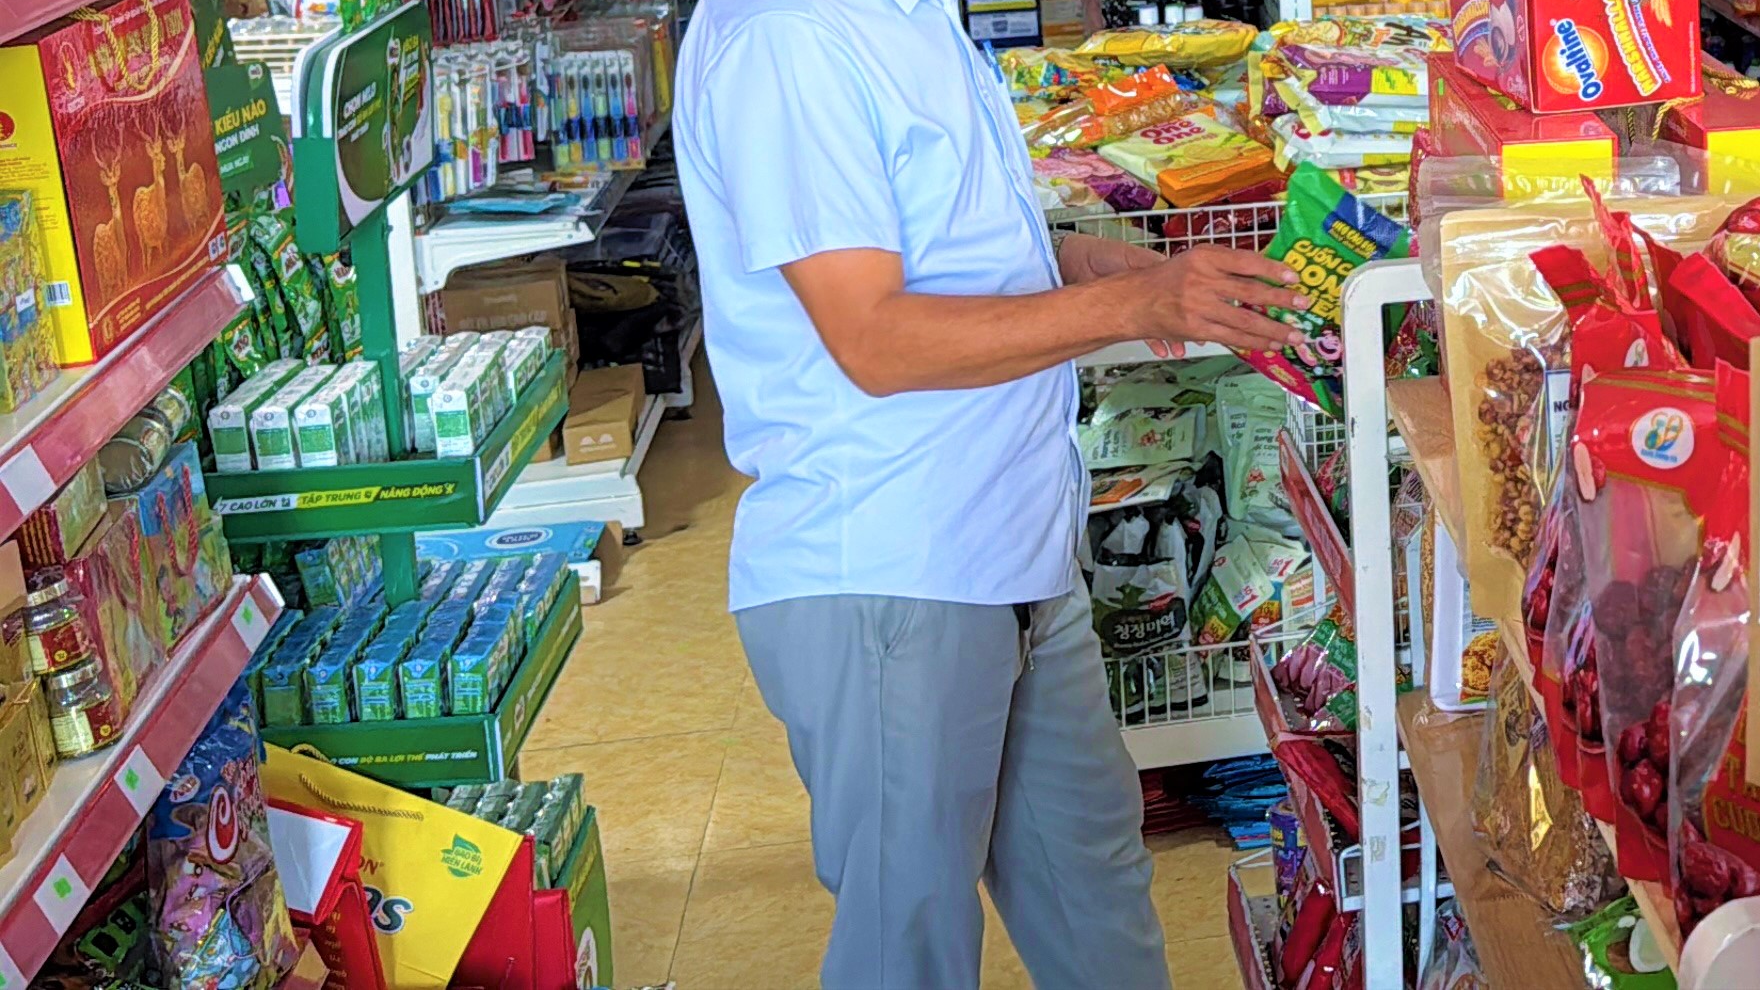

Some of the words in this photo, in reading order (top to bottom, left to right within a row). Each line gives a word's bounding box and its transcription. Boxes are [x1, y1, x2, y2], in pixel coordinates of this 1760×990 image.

[1554, 17, 1604, 102] Ovaltine
[242, 97, 268, 123] NÀO
[1139, 117, 1196, 141] One
[1152, 124, 1206, 146] One
[324, 489, 363, 504] TRUNG
[409, 482, 445, 499] ĐỘNG
[230, 499, 253, 512] CAO
[425, 750, 449, 761] PHÁT
